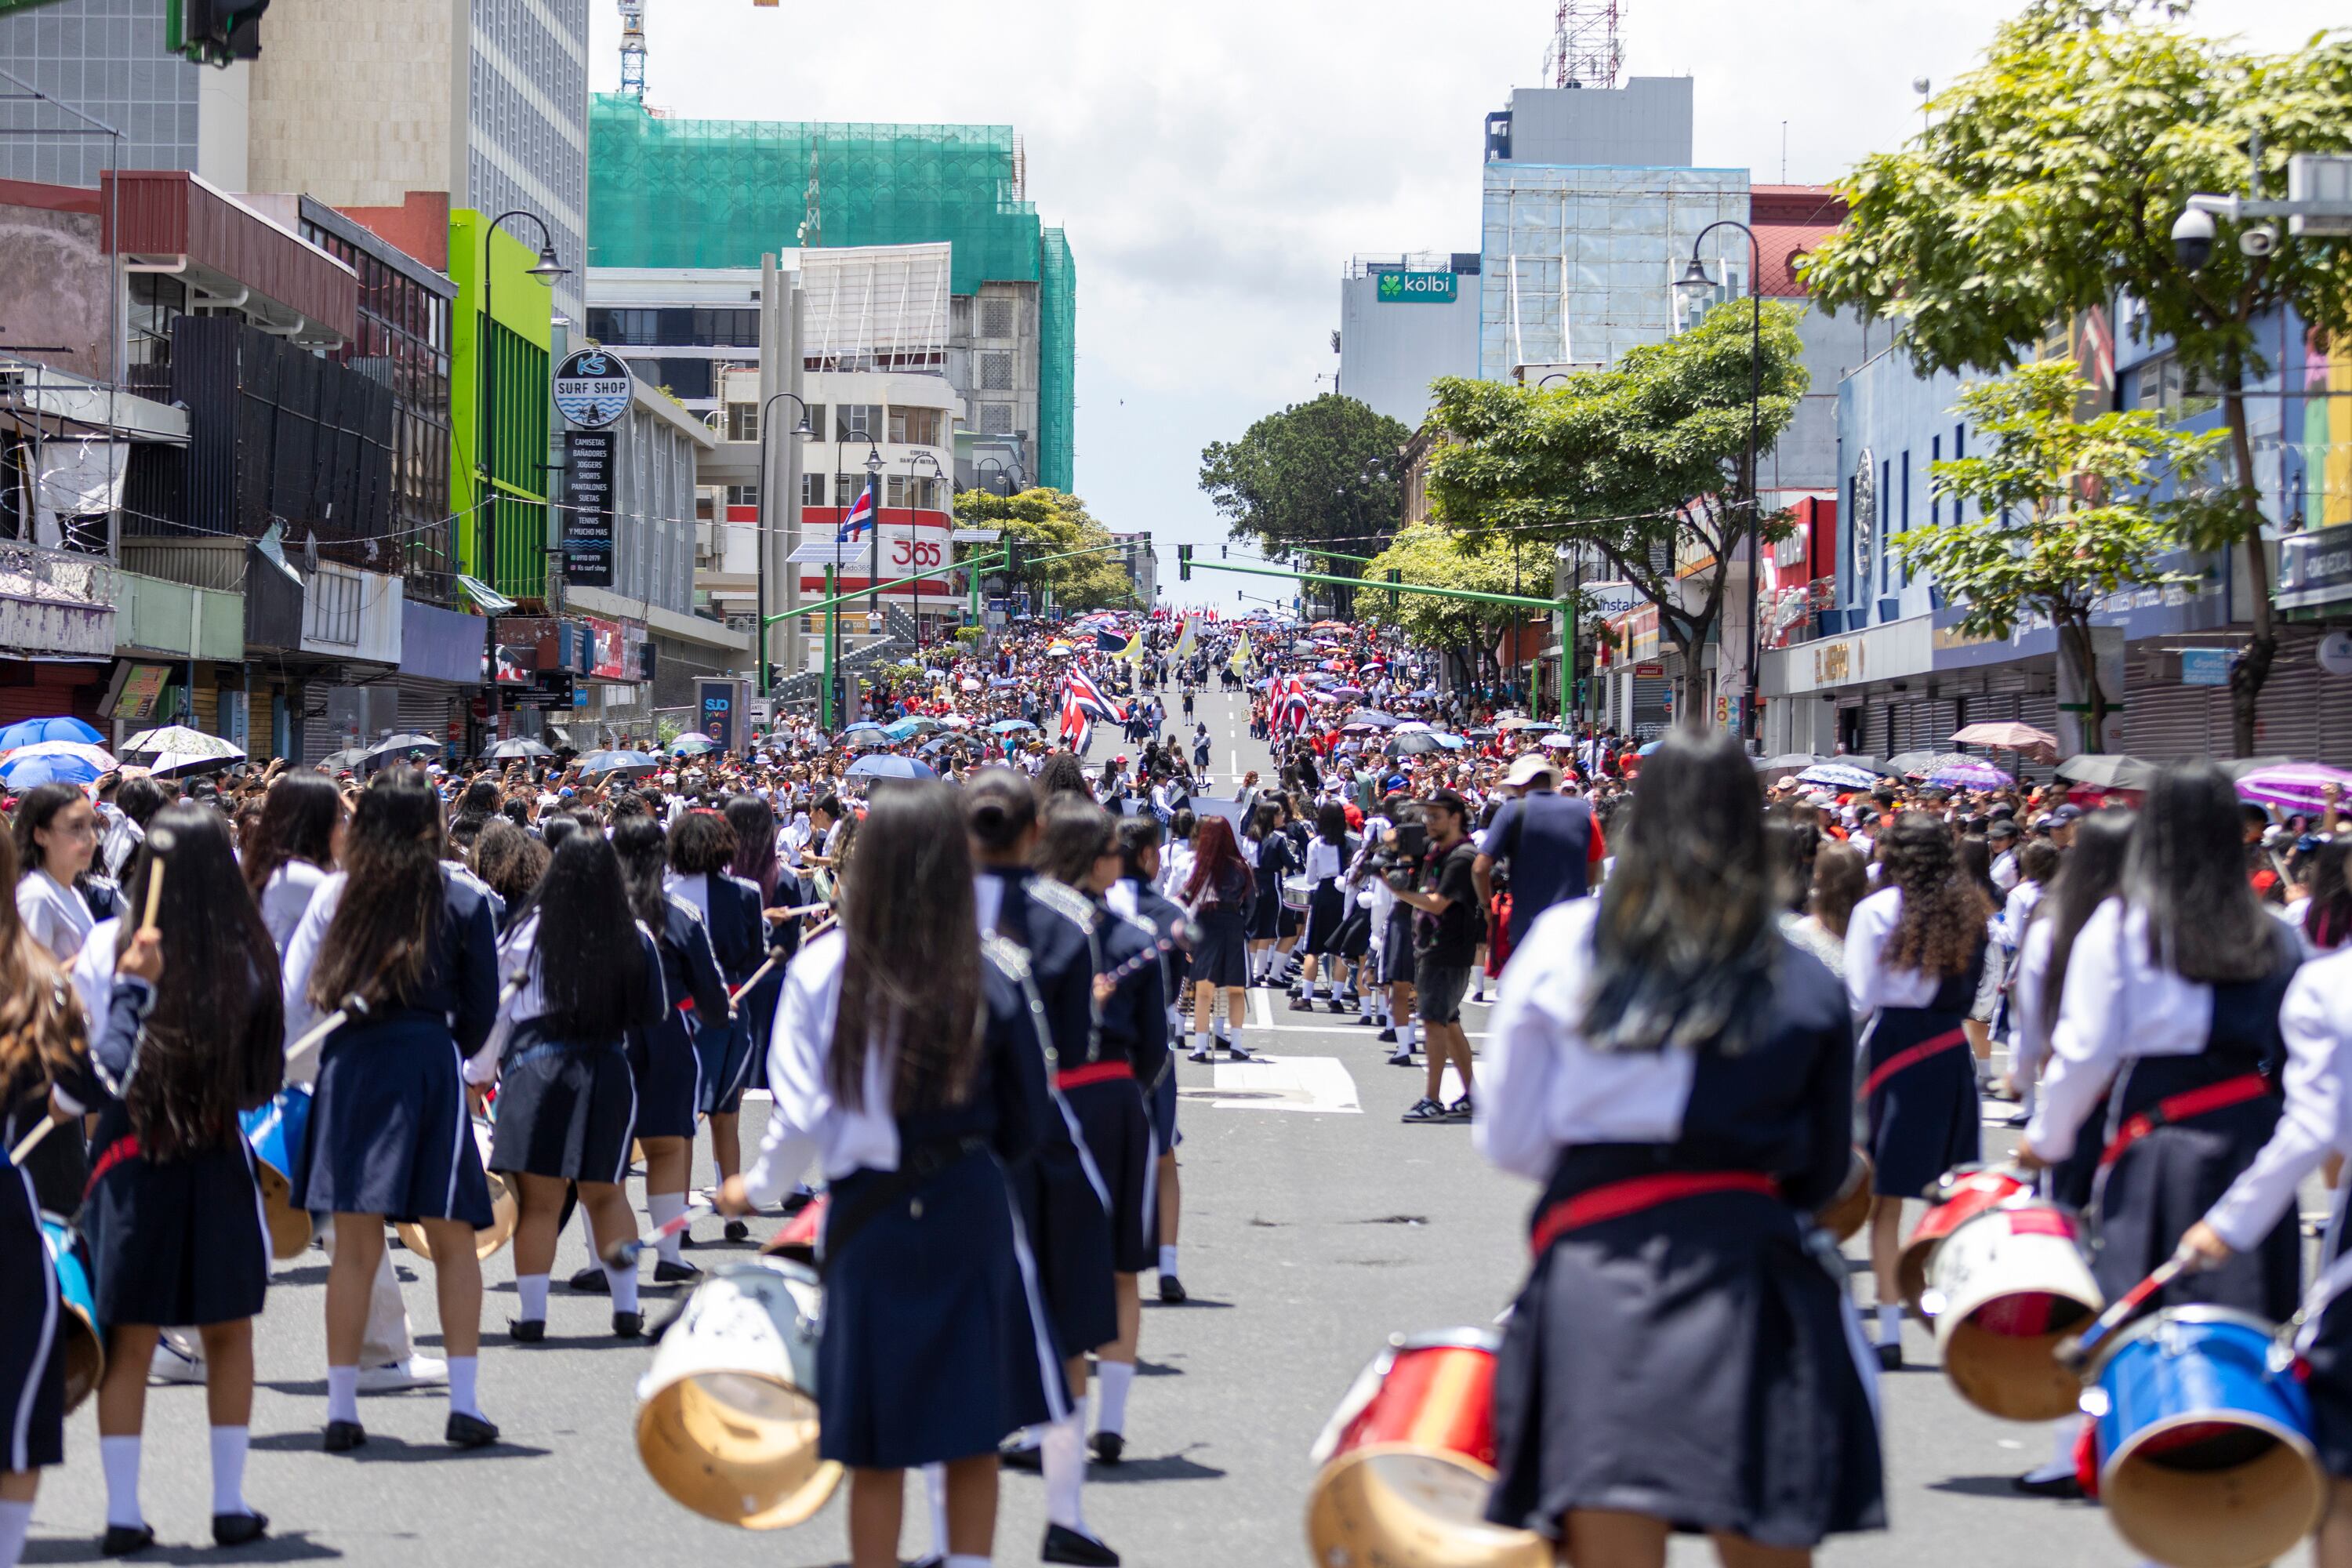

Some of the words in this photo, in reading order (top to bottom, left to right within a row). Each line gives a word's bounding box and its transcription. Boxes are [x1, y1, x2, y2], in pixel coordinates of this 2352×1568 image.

[1404, 275, 1450, 292] kölbi
[577, 357, 606, 376] KS
[558, 383, 589, 394] SURF
[594, 382, 626, 394] SHOP
[572, 448, 607, 457] BAÑADORES
[571, 483, 608, 492] PANTALONES
[892, 541, 941, 567] 365
[594, 564, 607, 573] shop
